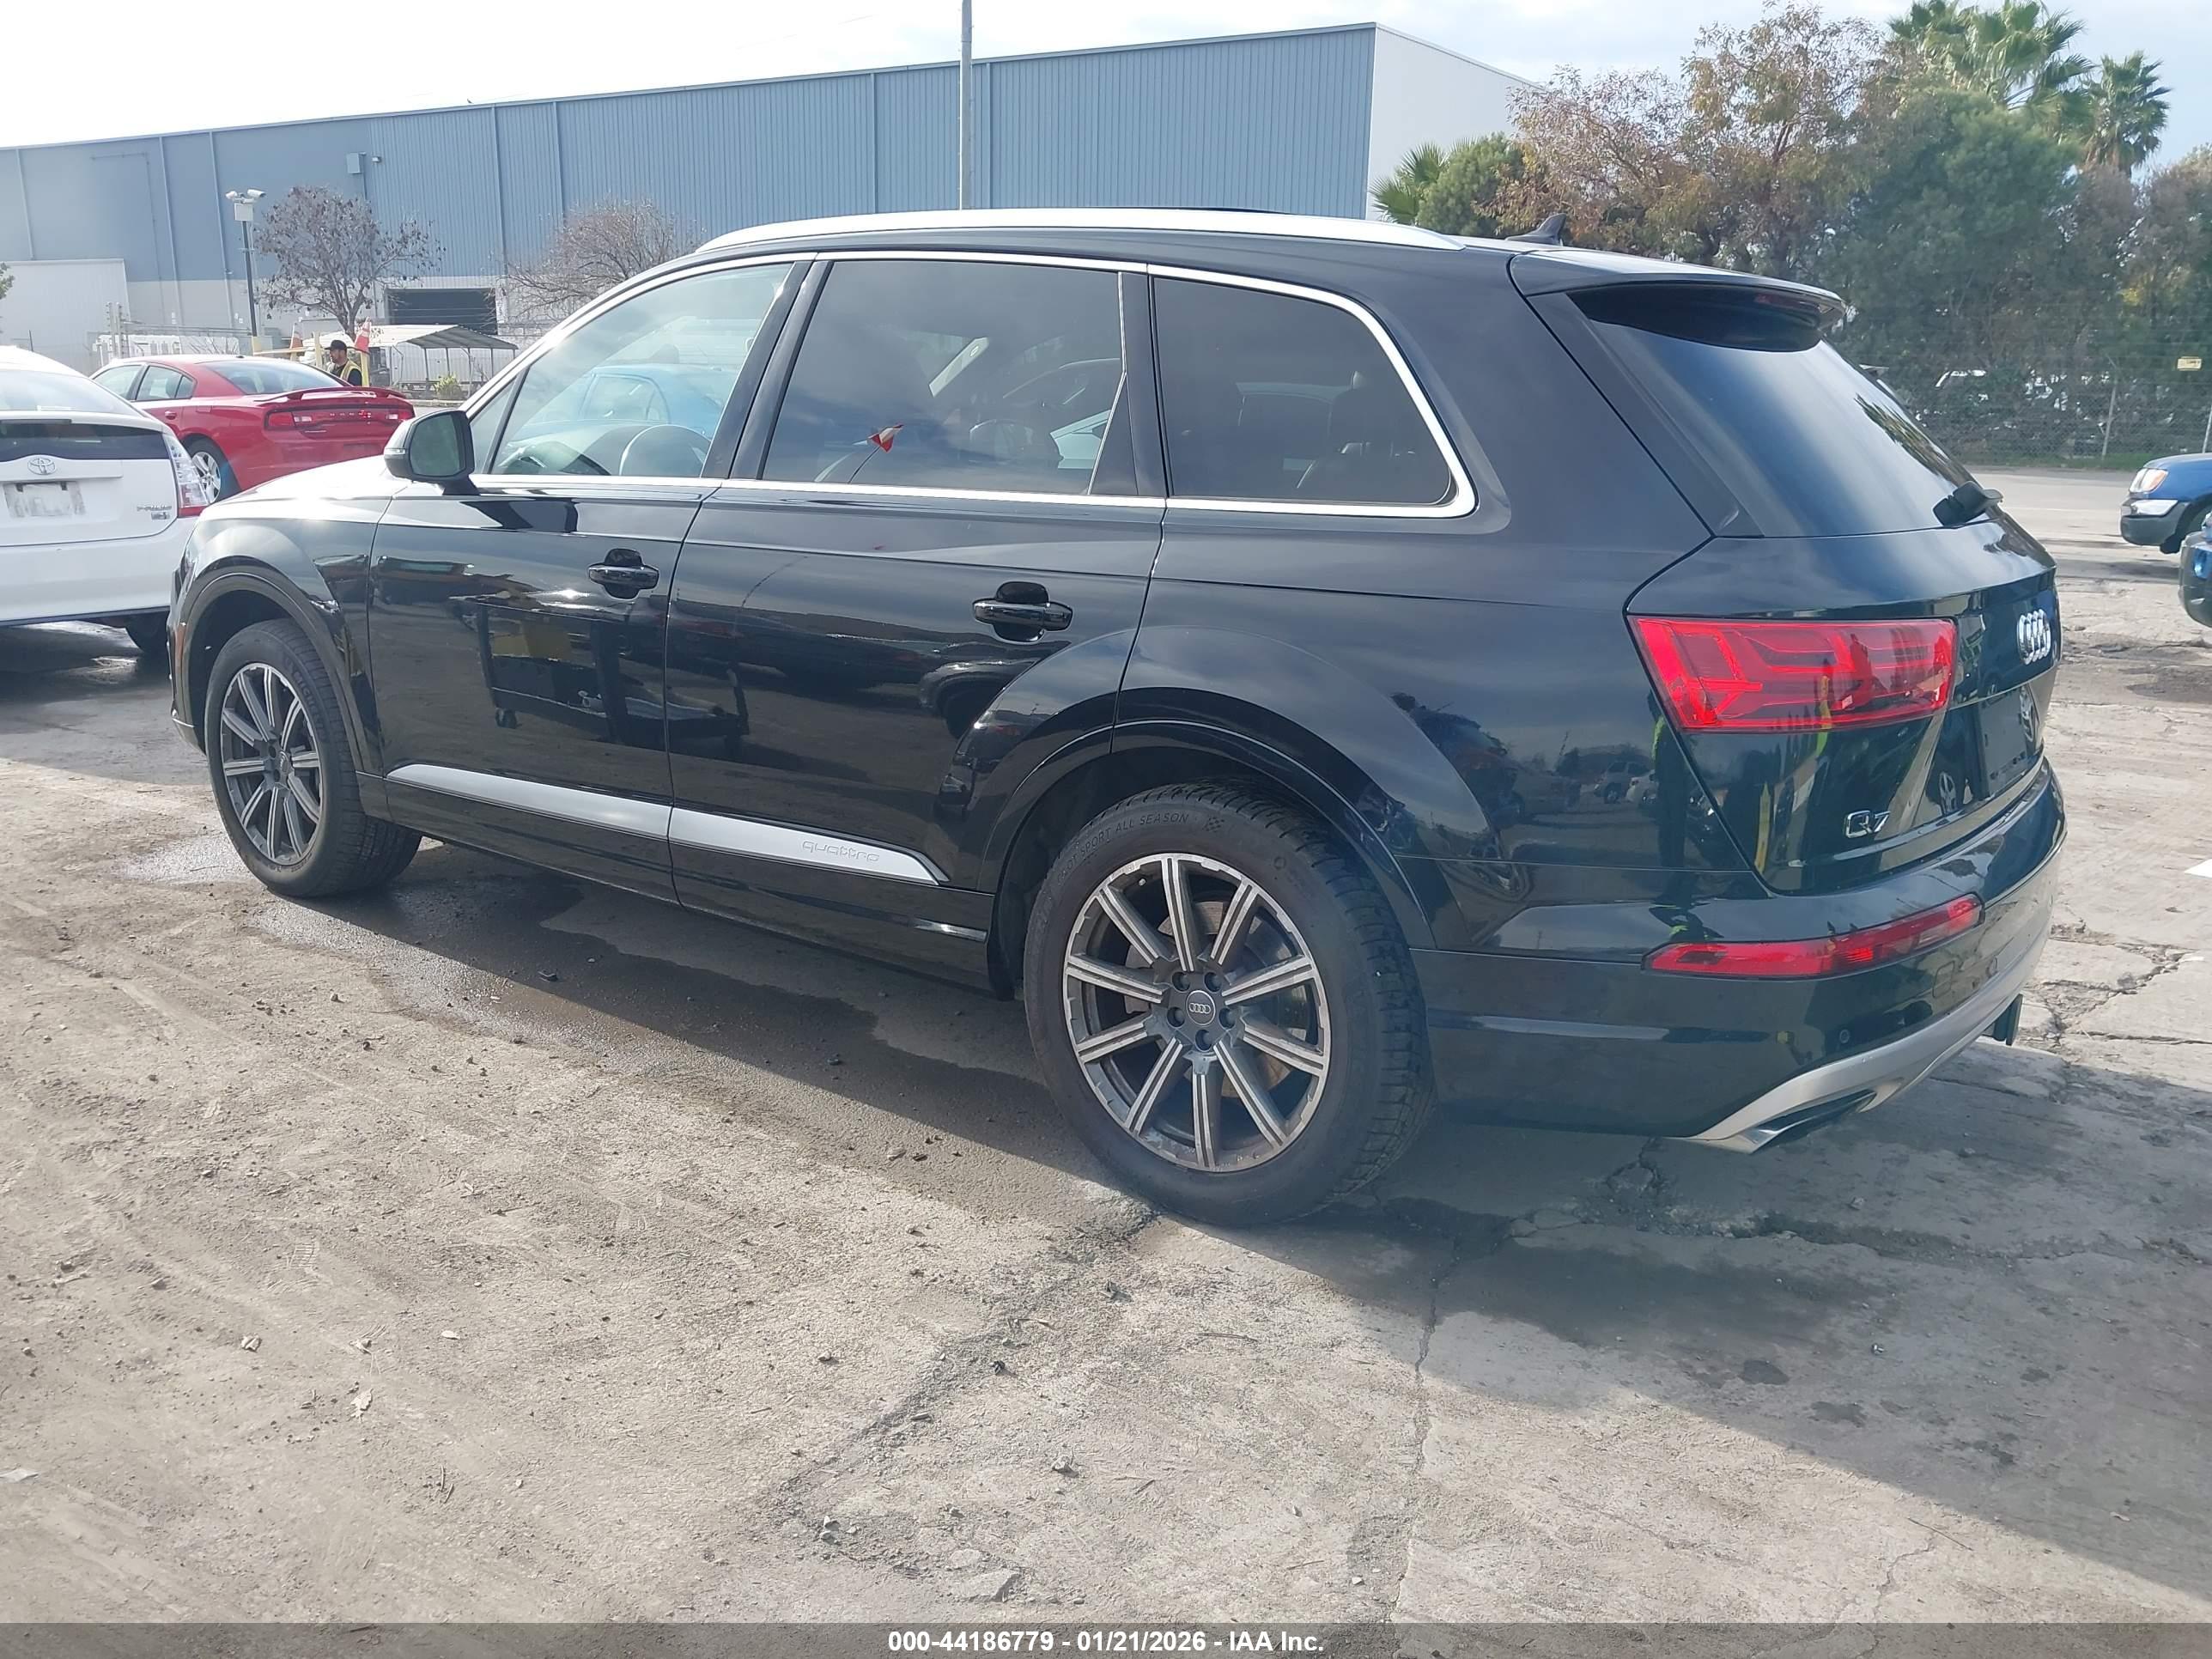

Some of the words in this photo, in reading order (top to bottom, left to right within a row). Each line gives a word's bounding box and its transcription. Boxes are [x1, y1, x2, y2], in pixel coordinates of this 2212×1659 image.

[1080, 827, 1112, 856] SPORT
[1115, 818, 1134, 832] ALL
[1139, 812, 1190, 825] SEASON
[1845, 810, 1891, 838] Q7
[802, 841, 880, 862] quattro
